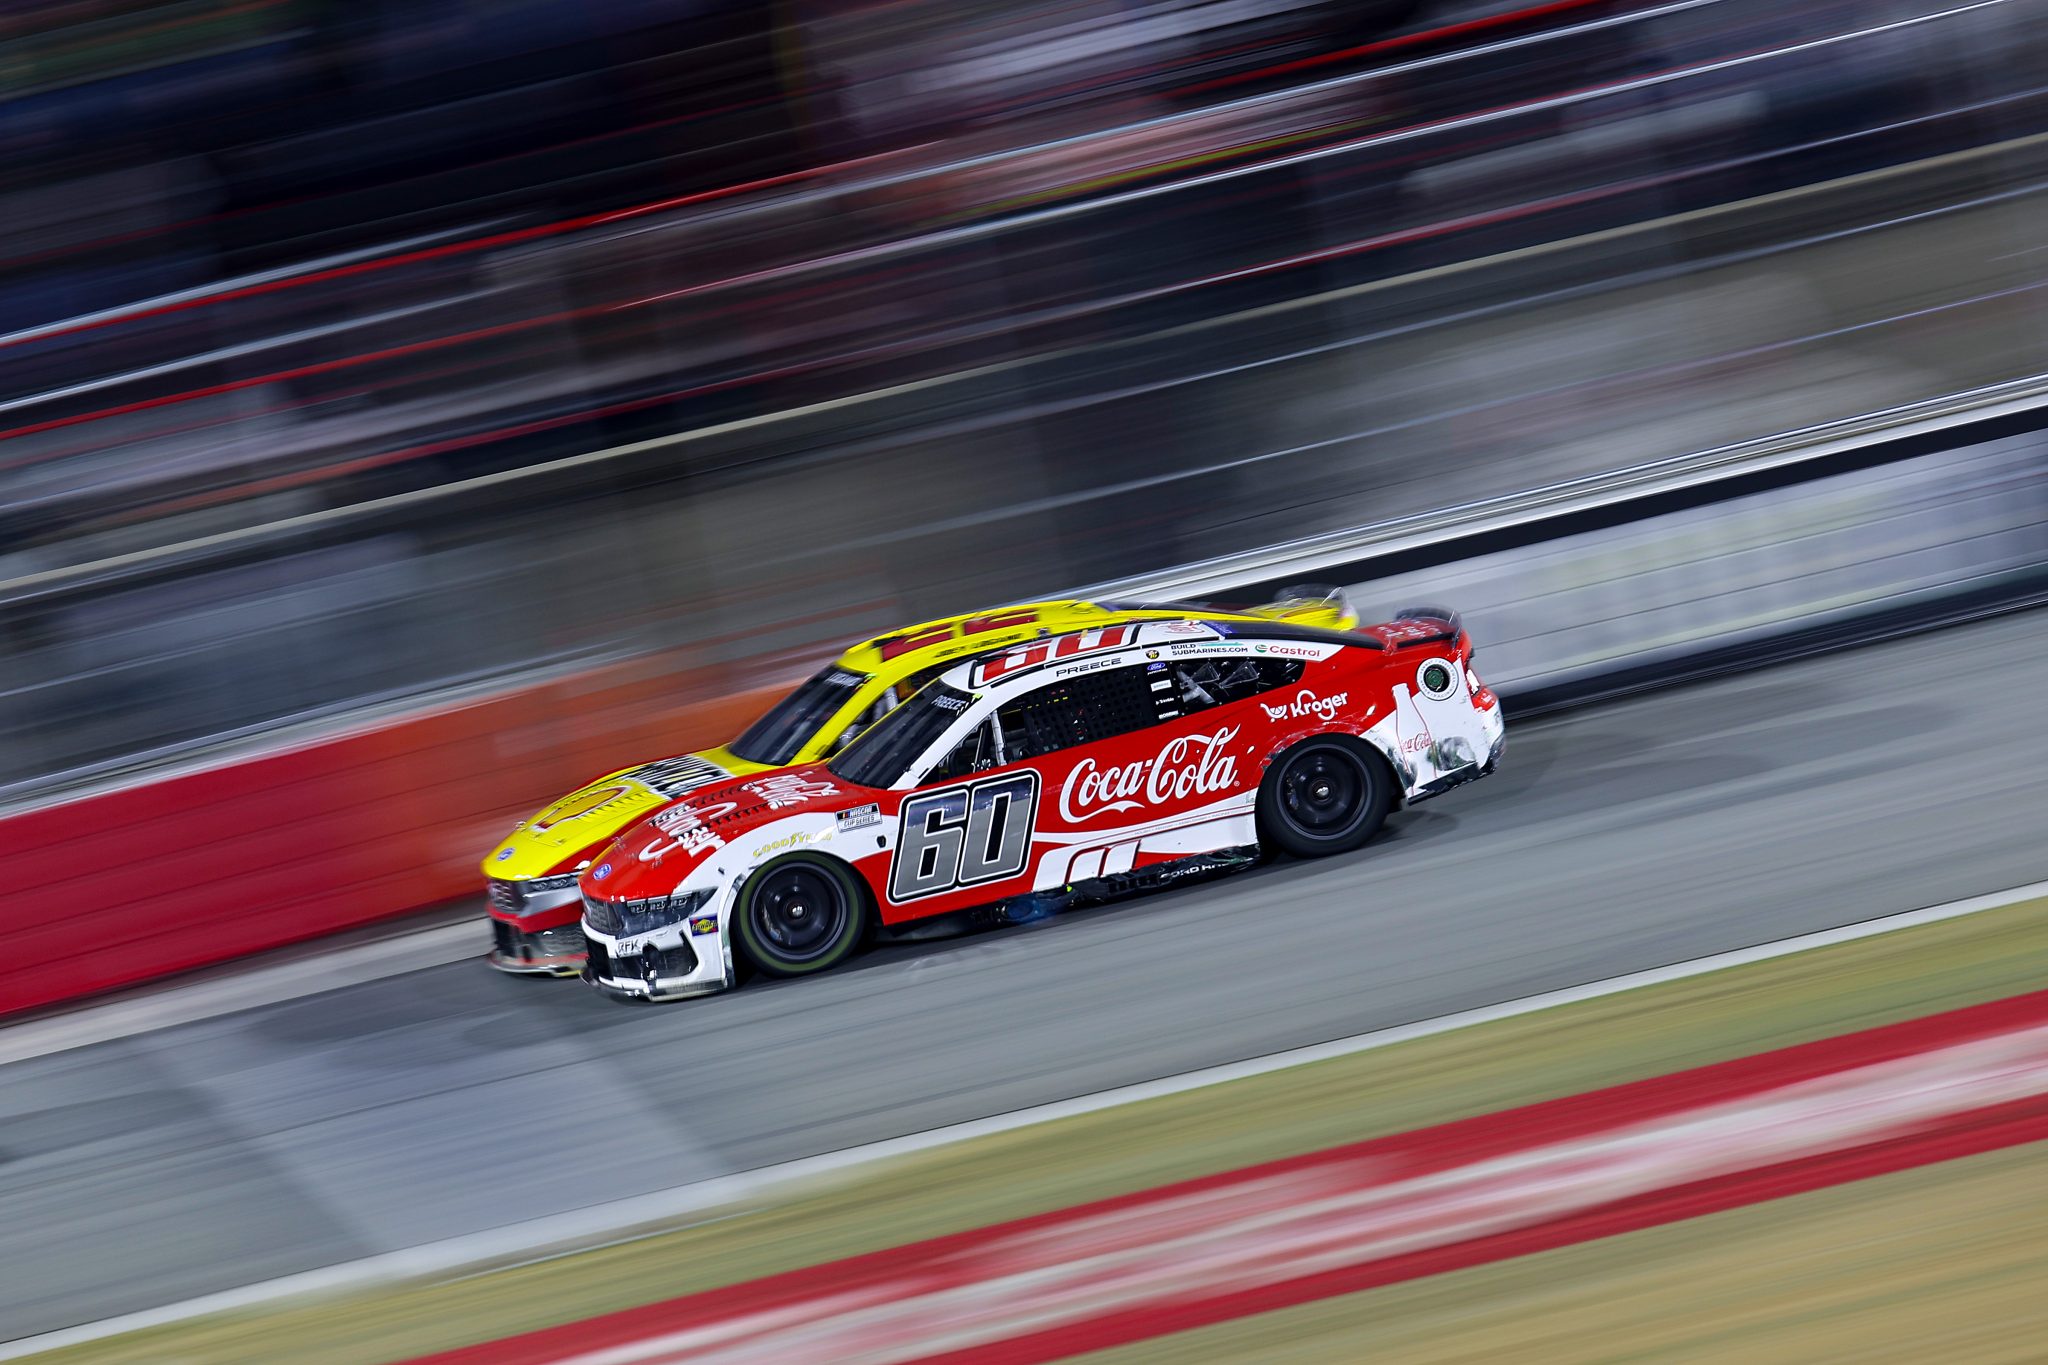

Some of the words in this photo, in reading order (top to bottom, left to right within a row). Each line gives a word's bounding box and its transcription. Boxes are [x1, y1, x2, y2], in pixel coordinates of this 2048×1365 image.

[1172, 646, 1249, 656] SUBMARINES.COM
[1269, 645, 1320, 657] Castrol
[1056, 658, 1122, 678] PREECE
[931, 694, 966, 711] PREECE
[1290, 689, 1349, 721] Kroger
[1059, 723, 1241, 823] Coca-Cola
[888, 769, 1040, 904] 60
